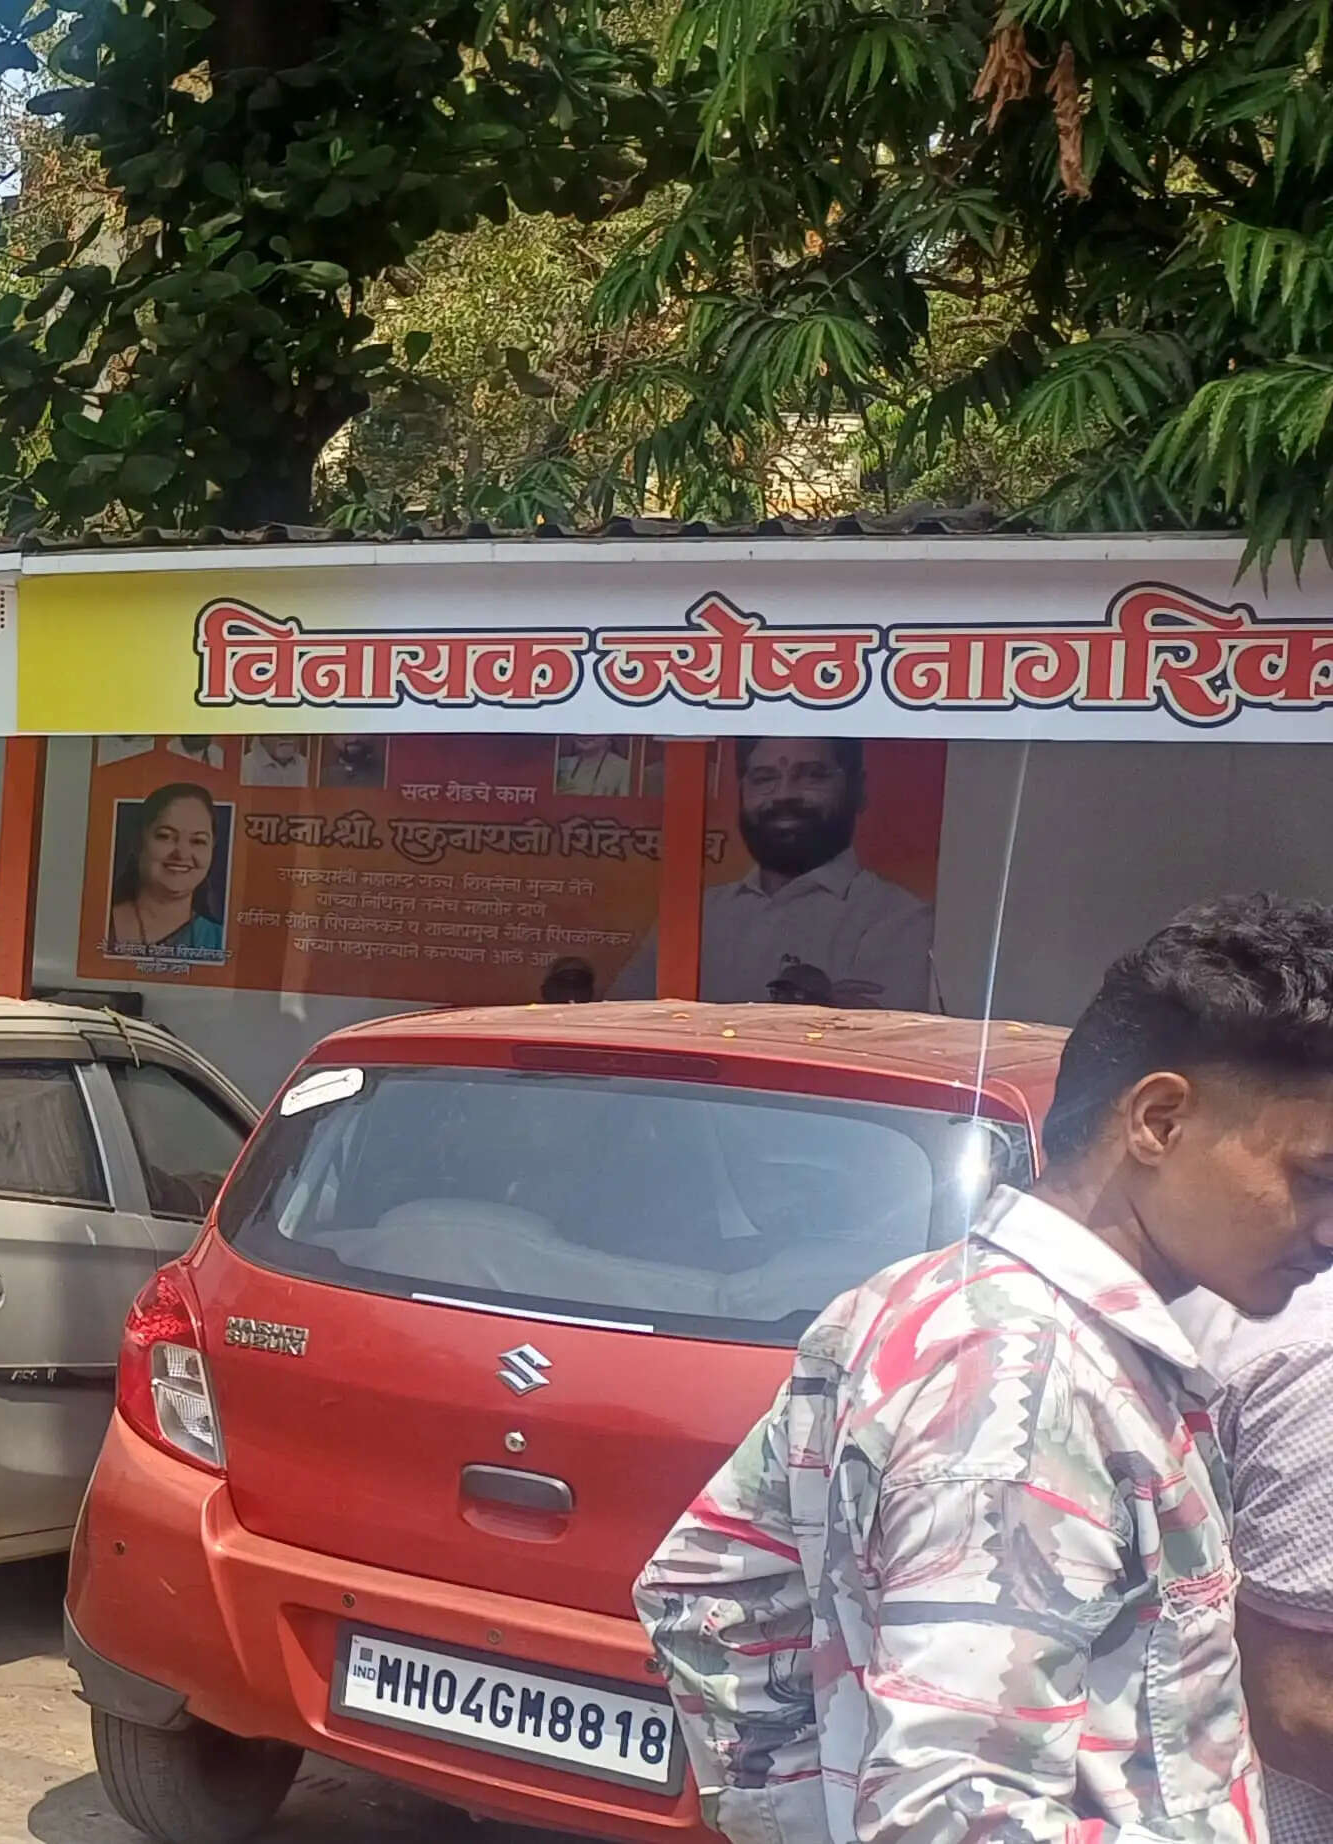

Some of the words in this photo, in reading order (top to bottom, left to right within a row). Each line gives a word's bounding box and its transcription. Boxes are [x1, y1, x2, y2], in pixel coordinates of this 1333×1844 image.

[197, 600, 587, 705] विनायक
[597, 594, 879, 707] ज्येष्ठ
[885, 585, 1333, 724] नागरिक
[400, 783, 441, 802] सदर
[445, 781, 491, 803] शेडचे
[495, 785, 537, 804] काम
[389, 816, 553, 866] एकनाथजी
[558, 816, 631, 862] शिंदे
[224, 1328, 307, 1357] SUZUKI
[352, 1664, 376, 1681] IND
[376, 1653, 667, 1766] MH04GM8818
